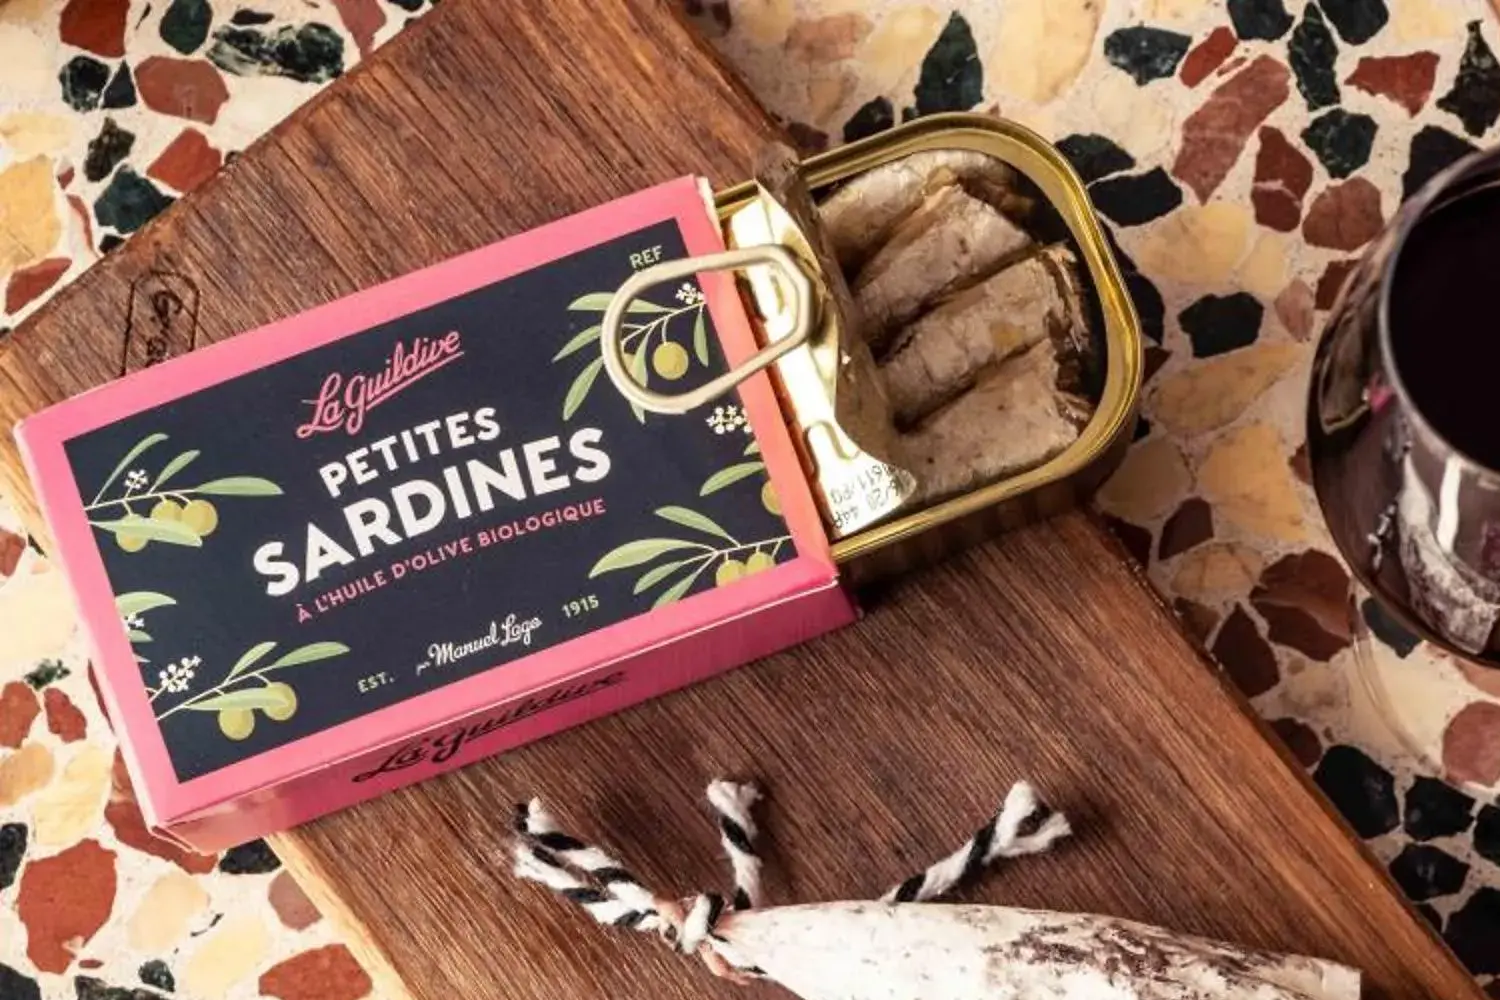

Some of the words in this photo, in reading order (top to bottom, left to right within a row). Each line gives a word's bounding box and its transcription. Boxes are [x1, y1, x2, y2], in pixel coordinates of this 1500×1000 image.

[628, 243, 663, 269] REF
[318, 402, 501, 498] PETITES
[252, 422, 612, 598] SARDINES
[295, 603, 313, 624] À
[314, 570, 388, 612] L'HUILE
[390, 536, 474, 580] D'OLIVE
[476, 497, 608, 549] BIOLOGIQUE
[356, 670, 396, 694] EST.
[425, 620, 500, 668] Manuel
[560, 593, 601, 619] 1915
